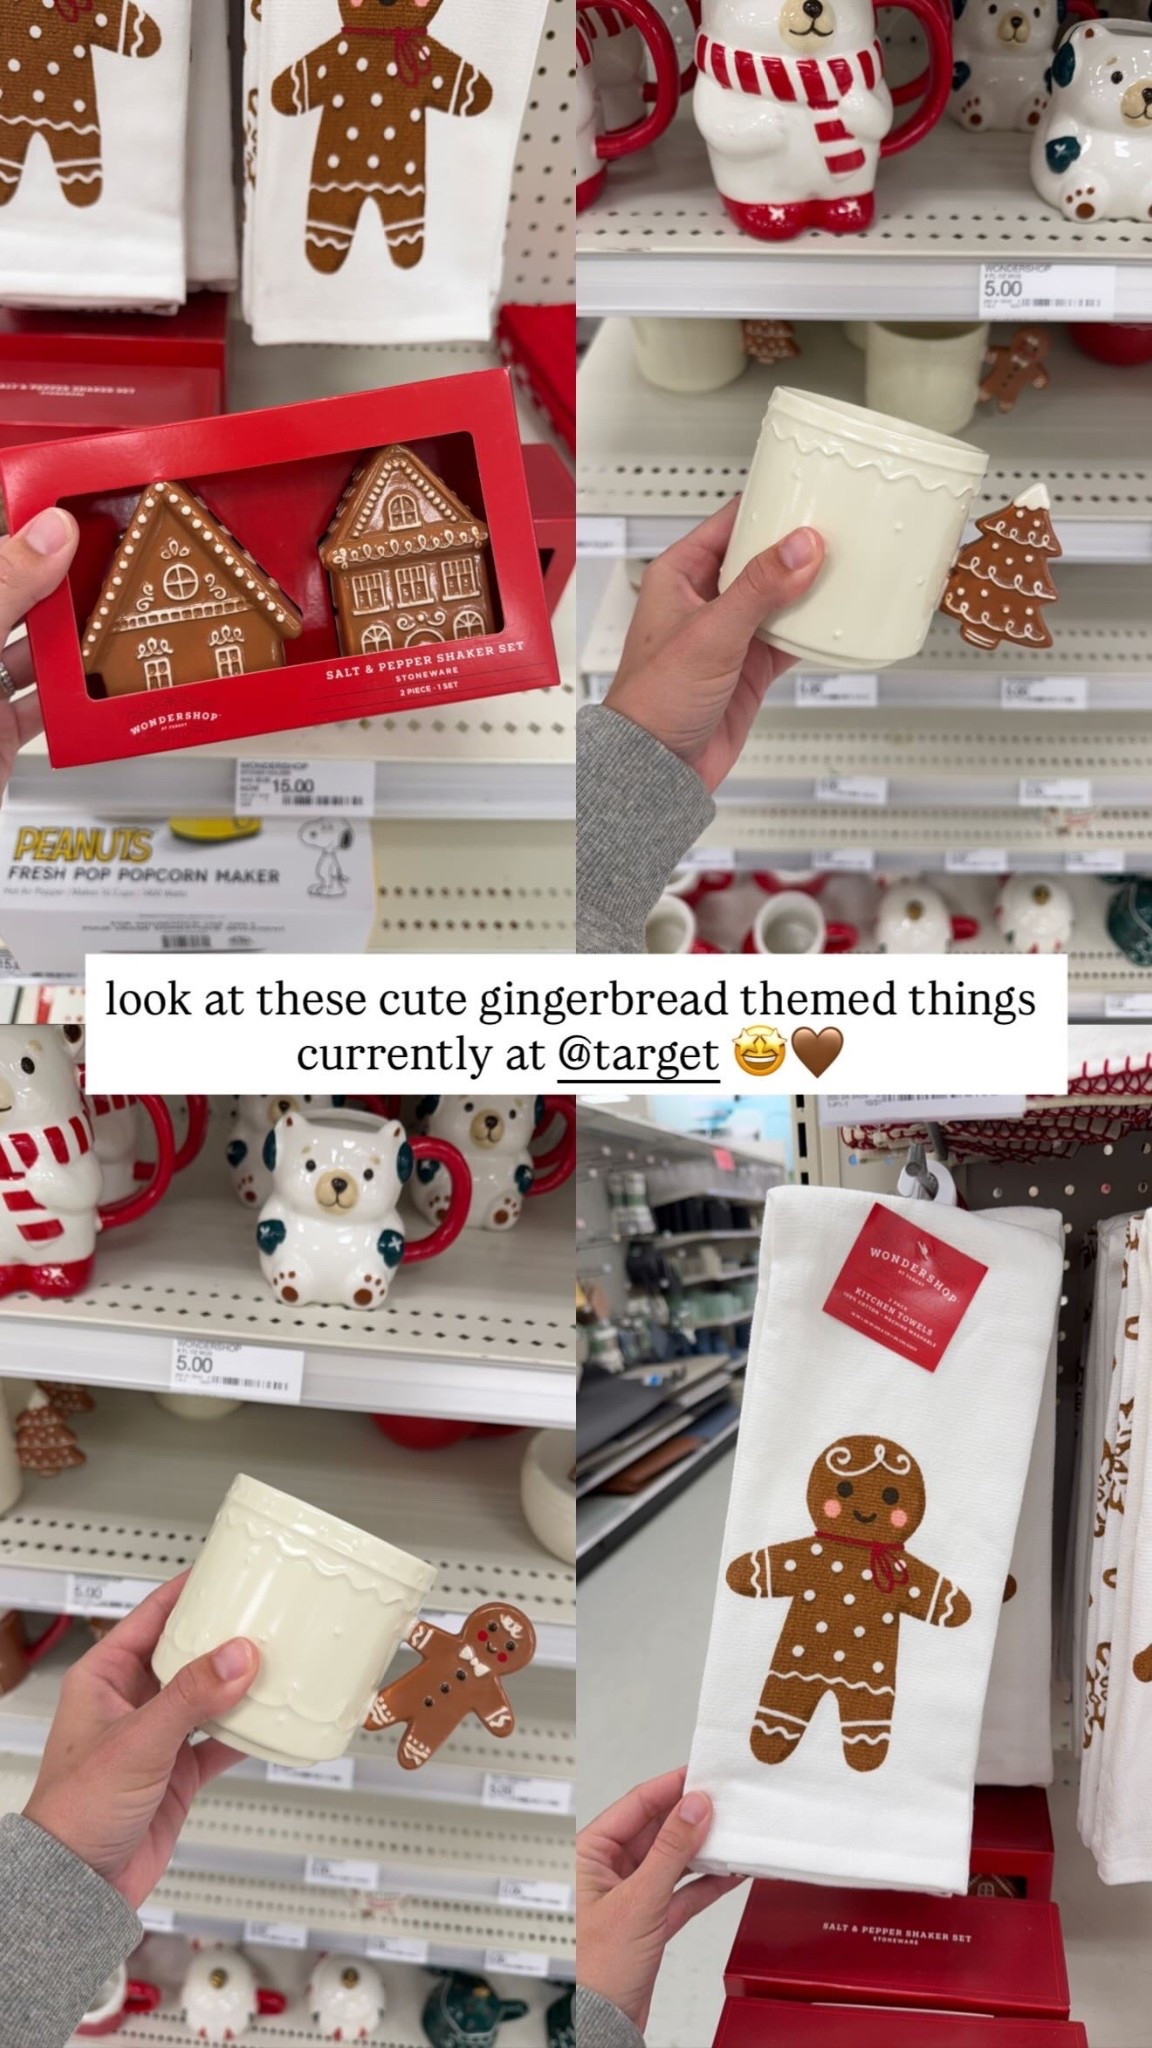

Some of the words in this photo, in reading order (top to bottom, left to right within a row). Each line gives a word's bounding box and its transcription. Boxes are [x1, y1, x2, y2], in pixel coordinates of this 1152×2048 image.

[984, 280, 1023, 297] 5.00
[326, 664, 360, 681] SALT
[365, 663, 374, 674] &
[378, 655, 433, 672] PEPPER
[436, 646, 494, 663] SHAKER
[499, 641, 525, 654] SET
[395, 666, 459, 683] STONEWARE
[400, 689, 406, 697] 2
[407, 685, 432, 695] PIECE
[443, 681, 459, 691] SET
[129, 711, 219, 736] WONDERSHOP
[273, 778, 315, 793] 15.00
[13, 826, 154, 863] PEANUTS
[8, 865, 66, 881] FRESH
[74, 866, 112, 882] POP
[117, 866, 209, 883] POPCORN
[214, 868, 281, 883] MAKER
[869, 1246, 958, 1304] WONDERSHOP
[854, 1286, 896, 1315] KITCHEN
[898, 1311, 933, 1337] TOWELS
[857, 1299, 880, 1317] COTTON
[884, 1314, 908, 1333] MACHINE
[908, 1328, 937, 1349] WASHABLE
[175, 1354, 213, 1374] 5.00
[822, 1921, 849, 1932] SALT
[852, 1925, 858, 1933] &
[862, 1925, 903, 1937] PEPPER
[905, 1929, 949, 1941] SHAKER
[952, 1933, 972, 1943] SET
[873, 1935, 919, 1946] STONEWARE
